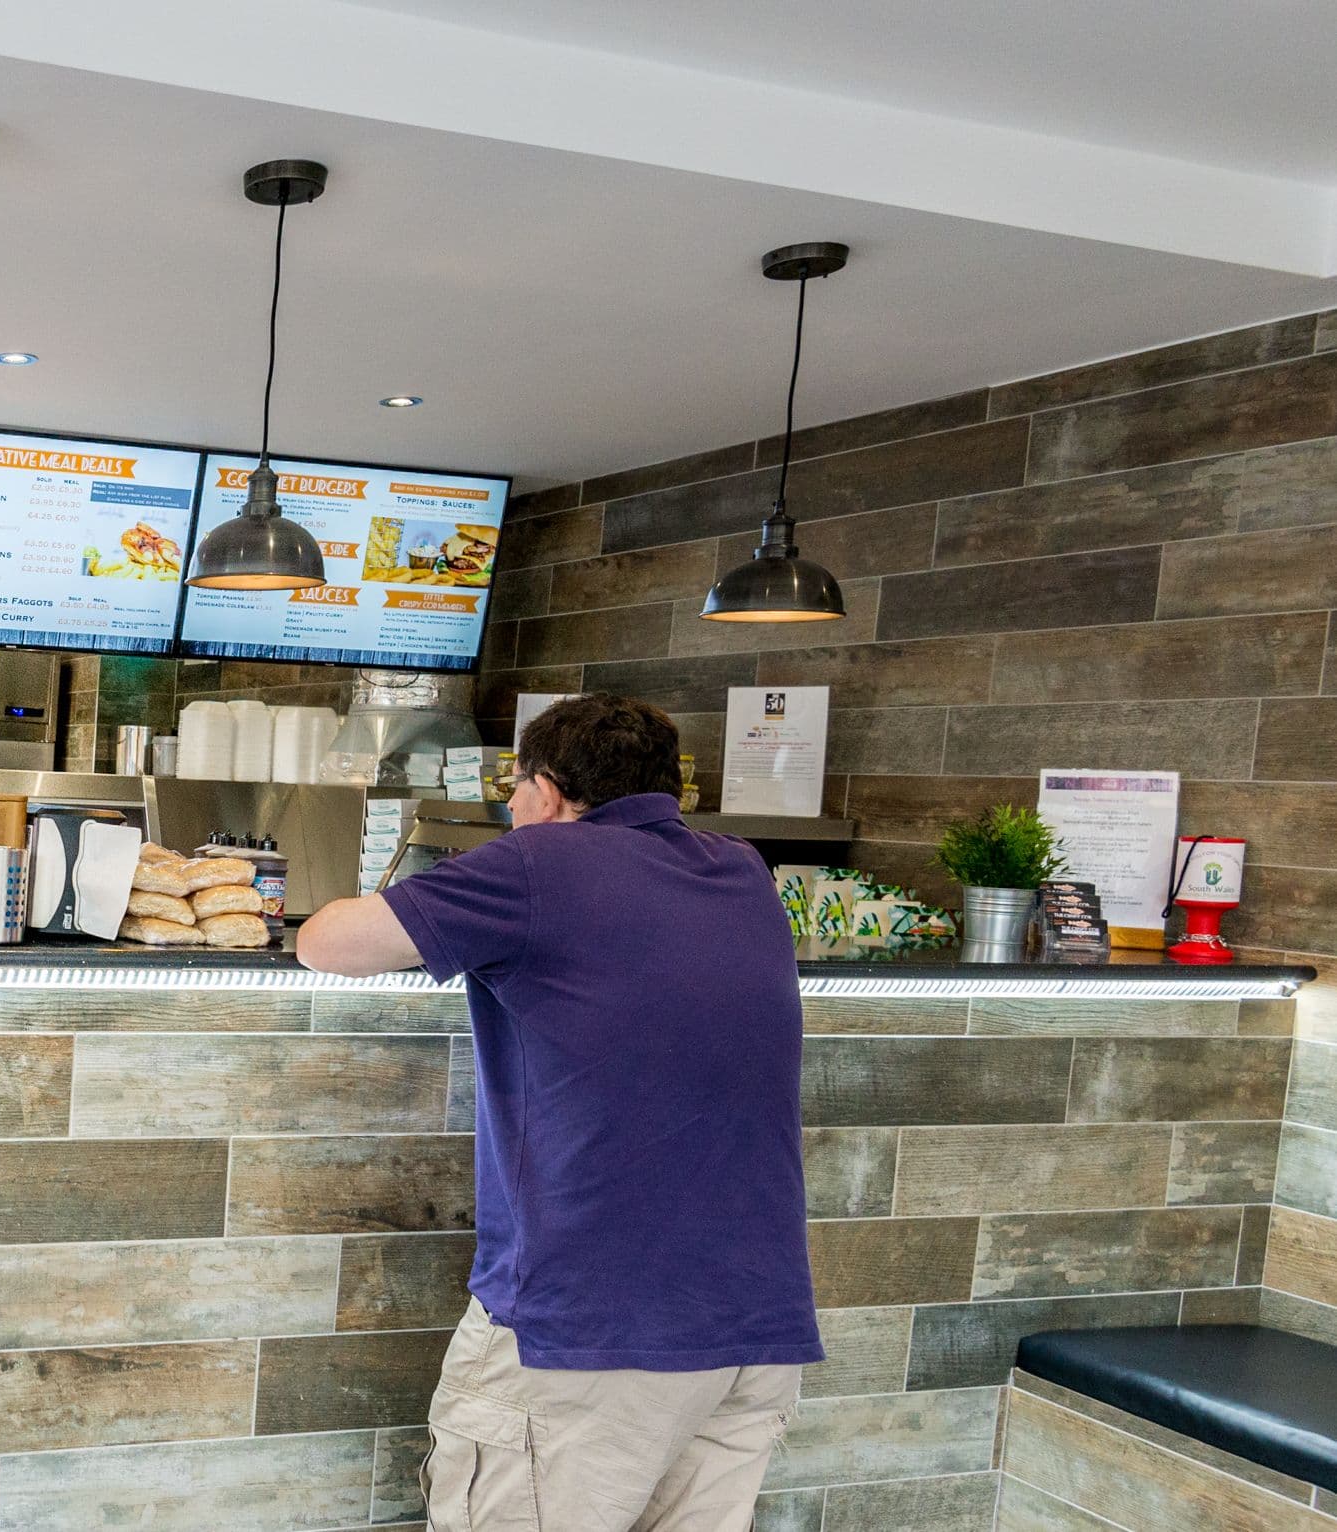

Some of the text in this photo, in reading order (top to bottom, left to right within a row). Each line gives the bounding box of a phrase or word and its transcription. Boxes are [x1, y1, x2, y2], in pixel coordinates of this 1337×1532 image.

[39, 453, 79, 471] MEAL
[80, 456, 123, 475] DEALS
[300, 479, 358, 497] BURGERS
[329, 543, 350, 556] SIDE
[299, 587, 350, 603] SAUCES
[422, 592, 445, 602] LITTLE
[11, 597, 53, 607] FAGGOTS
[398, 600, 422, 609] CRISPY
[423, 602, 437, 610] COB
[1, 613, 34, 622] CURRY
[766, 698, 784, 711] 50
[1188, 884, 1211, 892] South
